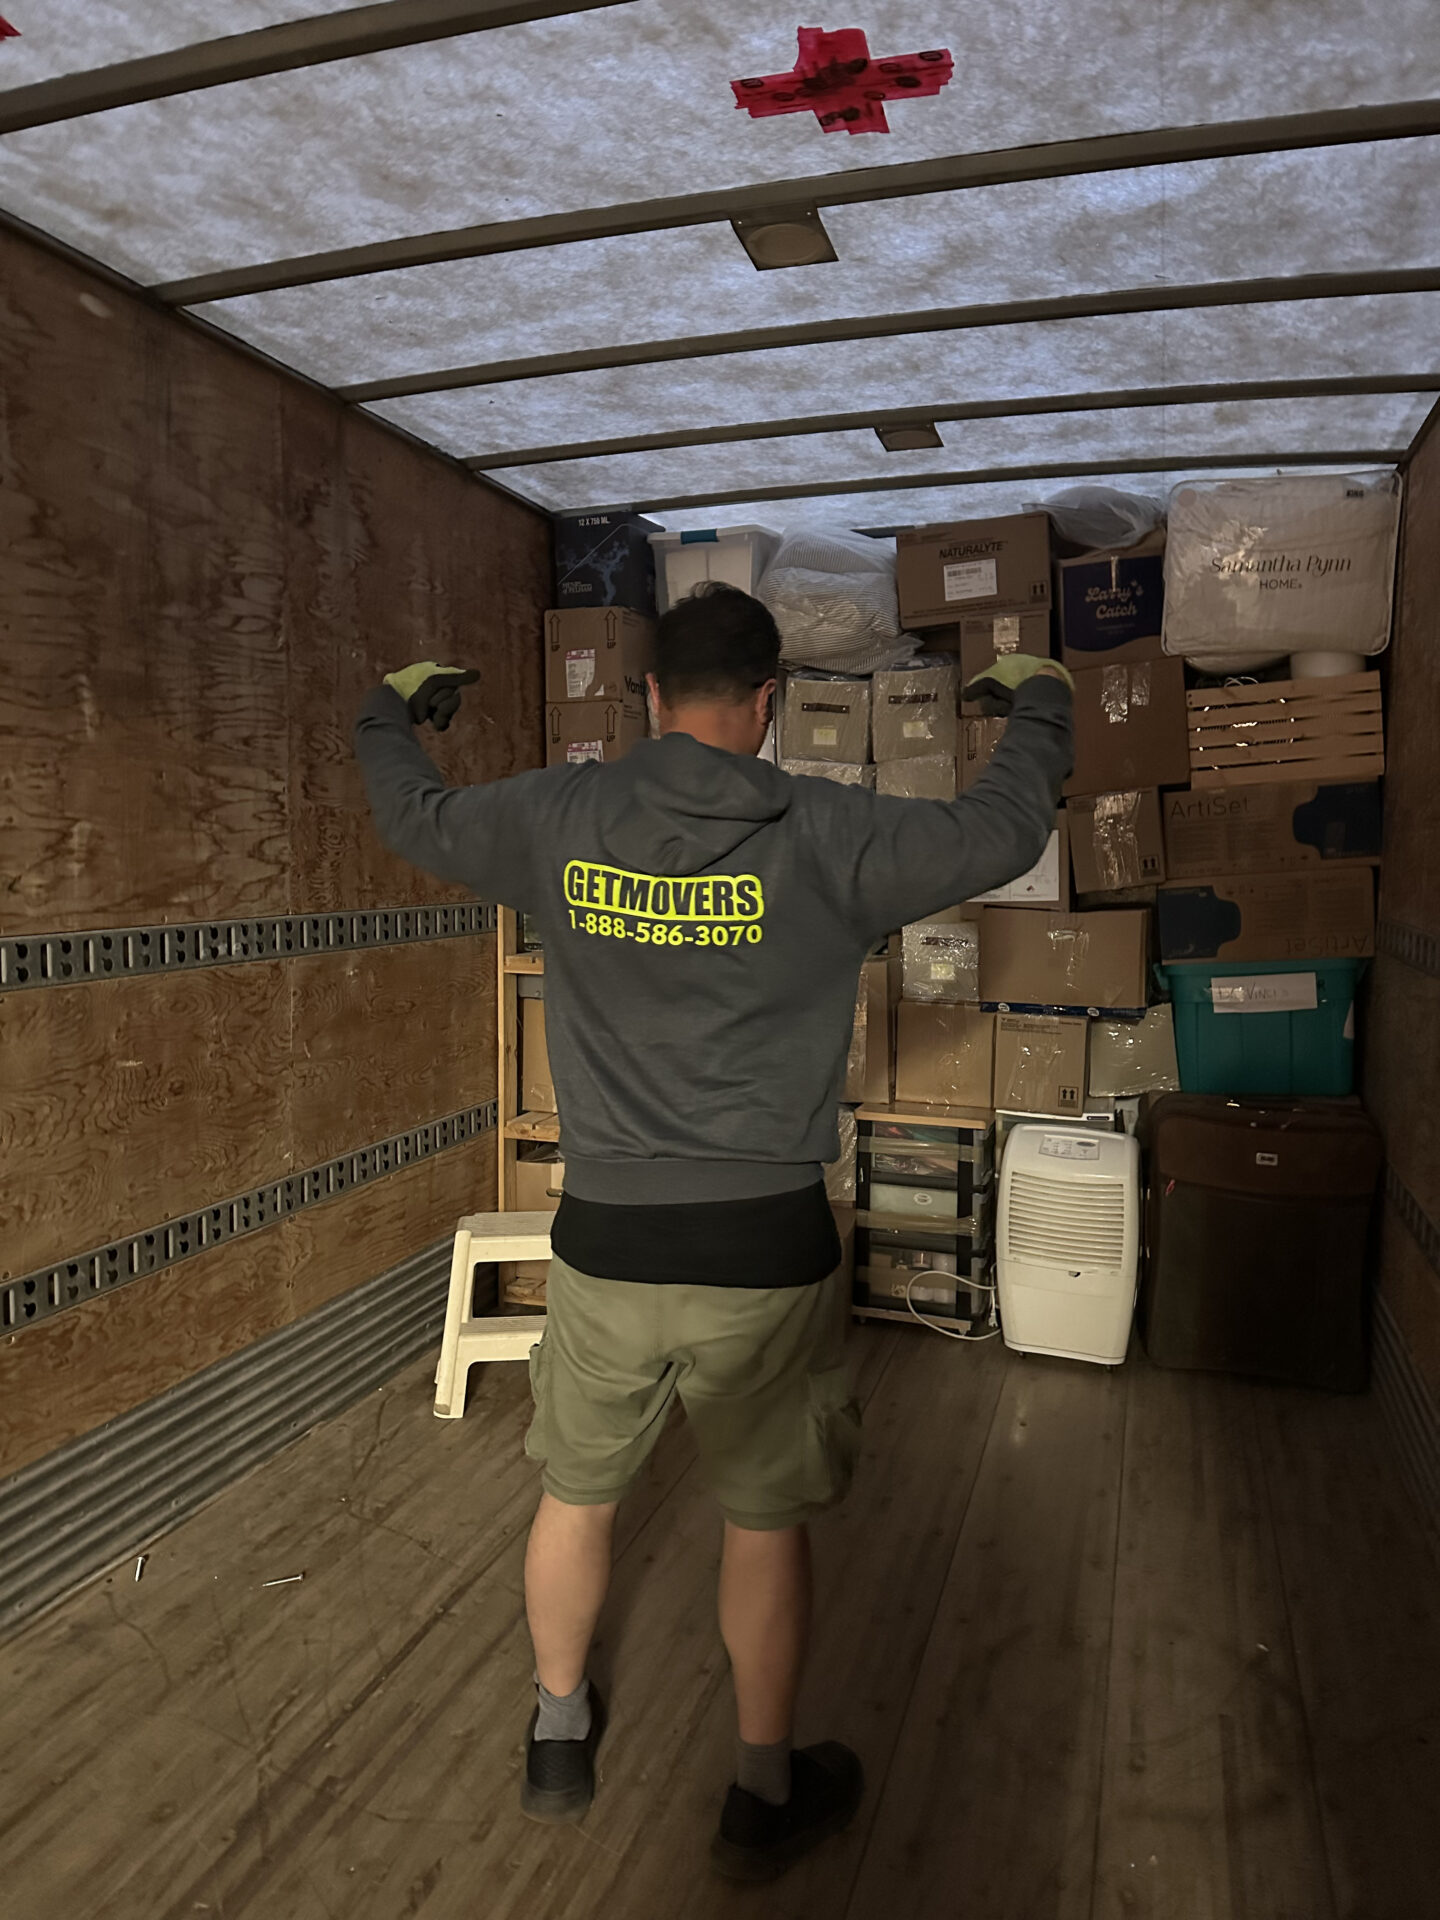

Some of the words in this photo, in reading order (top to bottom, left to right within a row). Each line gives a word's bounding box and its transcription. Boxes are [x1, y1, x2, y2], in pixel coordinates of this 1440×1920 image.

[939, 541, 1004, 559] NATURALYTE
[1211, 555, 1301, 573] Samantha
[1306, 555, 1351, 576] Pynn
[1084, 579, 1145, 603] Larry's
[1096, 601, 1138, 619] Catch
[606, 641, 617, 649] UP
[552, 736, 561, 744] UP
[606, 734, 616, 742] UP
[1171, 797, 1250, 819] ArtiSet
[567, 864, 758, 917] GETMOVERS
[568, 909, 763, 946] 1-888-586-3070
[1285, 935, 1368, 954] ArtiSet
